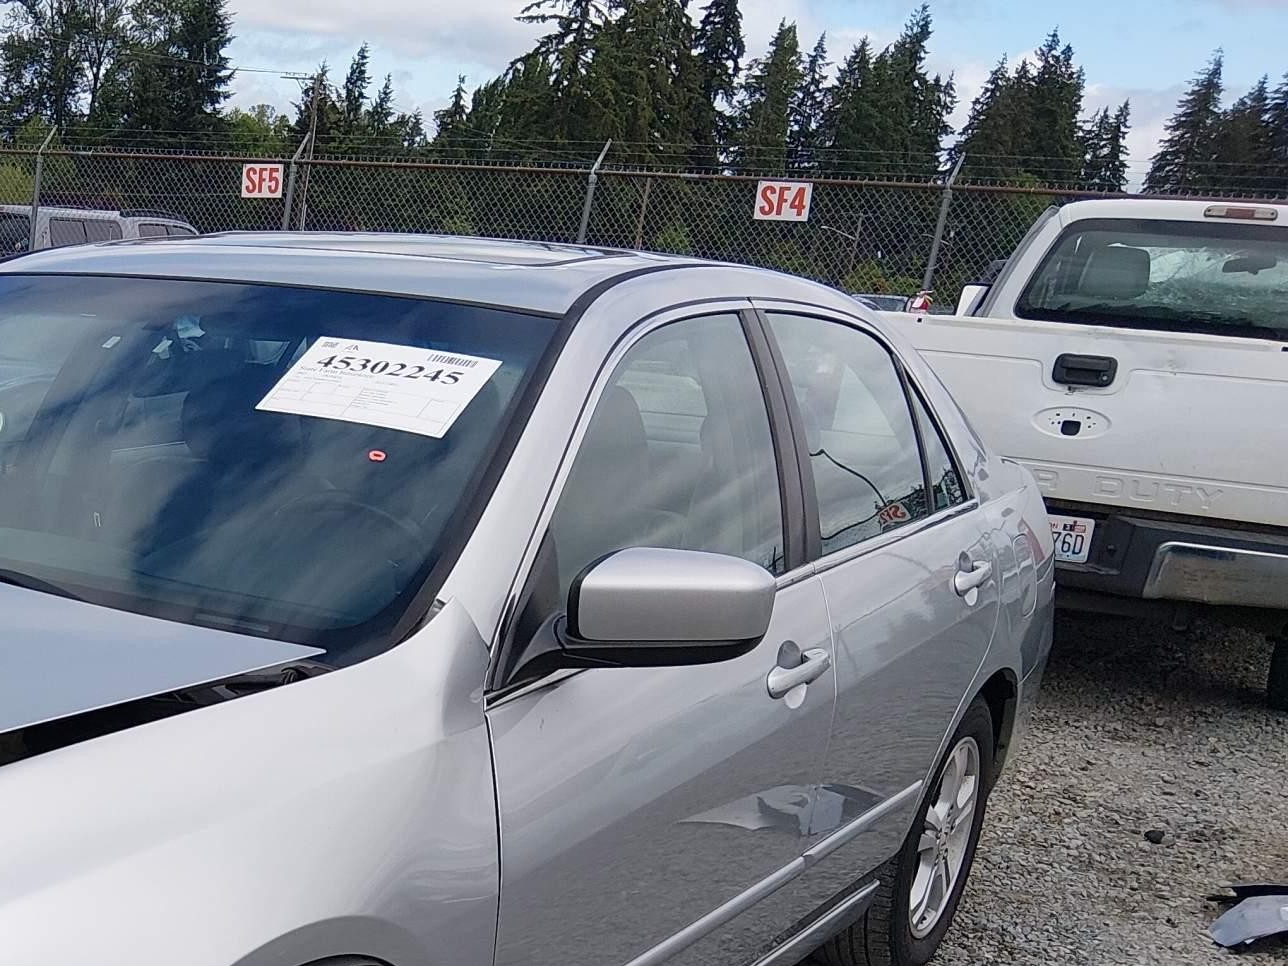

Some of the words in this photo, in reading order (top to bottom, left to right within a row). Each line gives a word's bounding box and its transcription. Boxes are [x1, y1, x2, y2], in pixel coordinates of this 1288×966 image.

[245, 167, 280, 194] SF5
[759, 185, 807, 217] SF4
[316, 354, 465, 385] 45302245
[1093, 474, 1224, 510] DUTY
